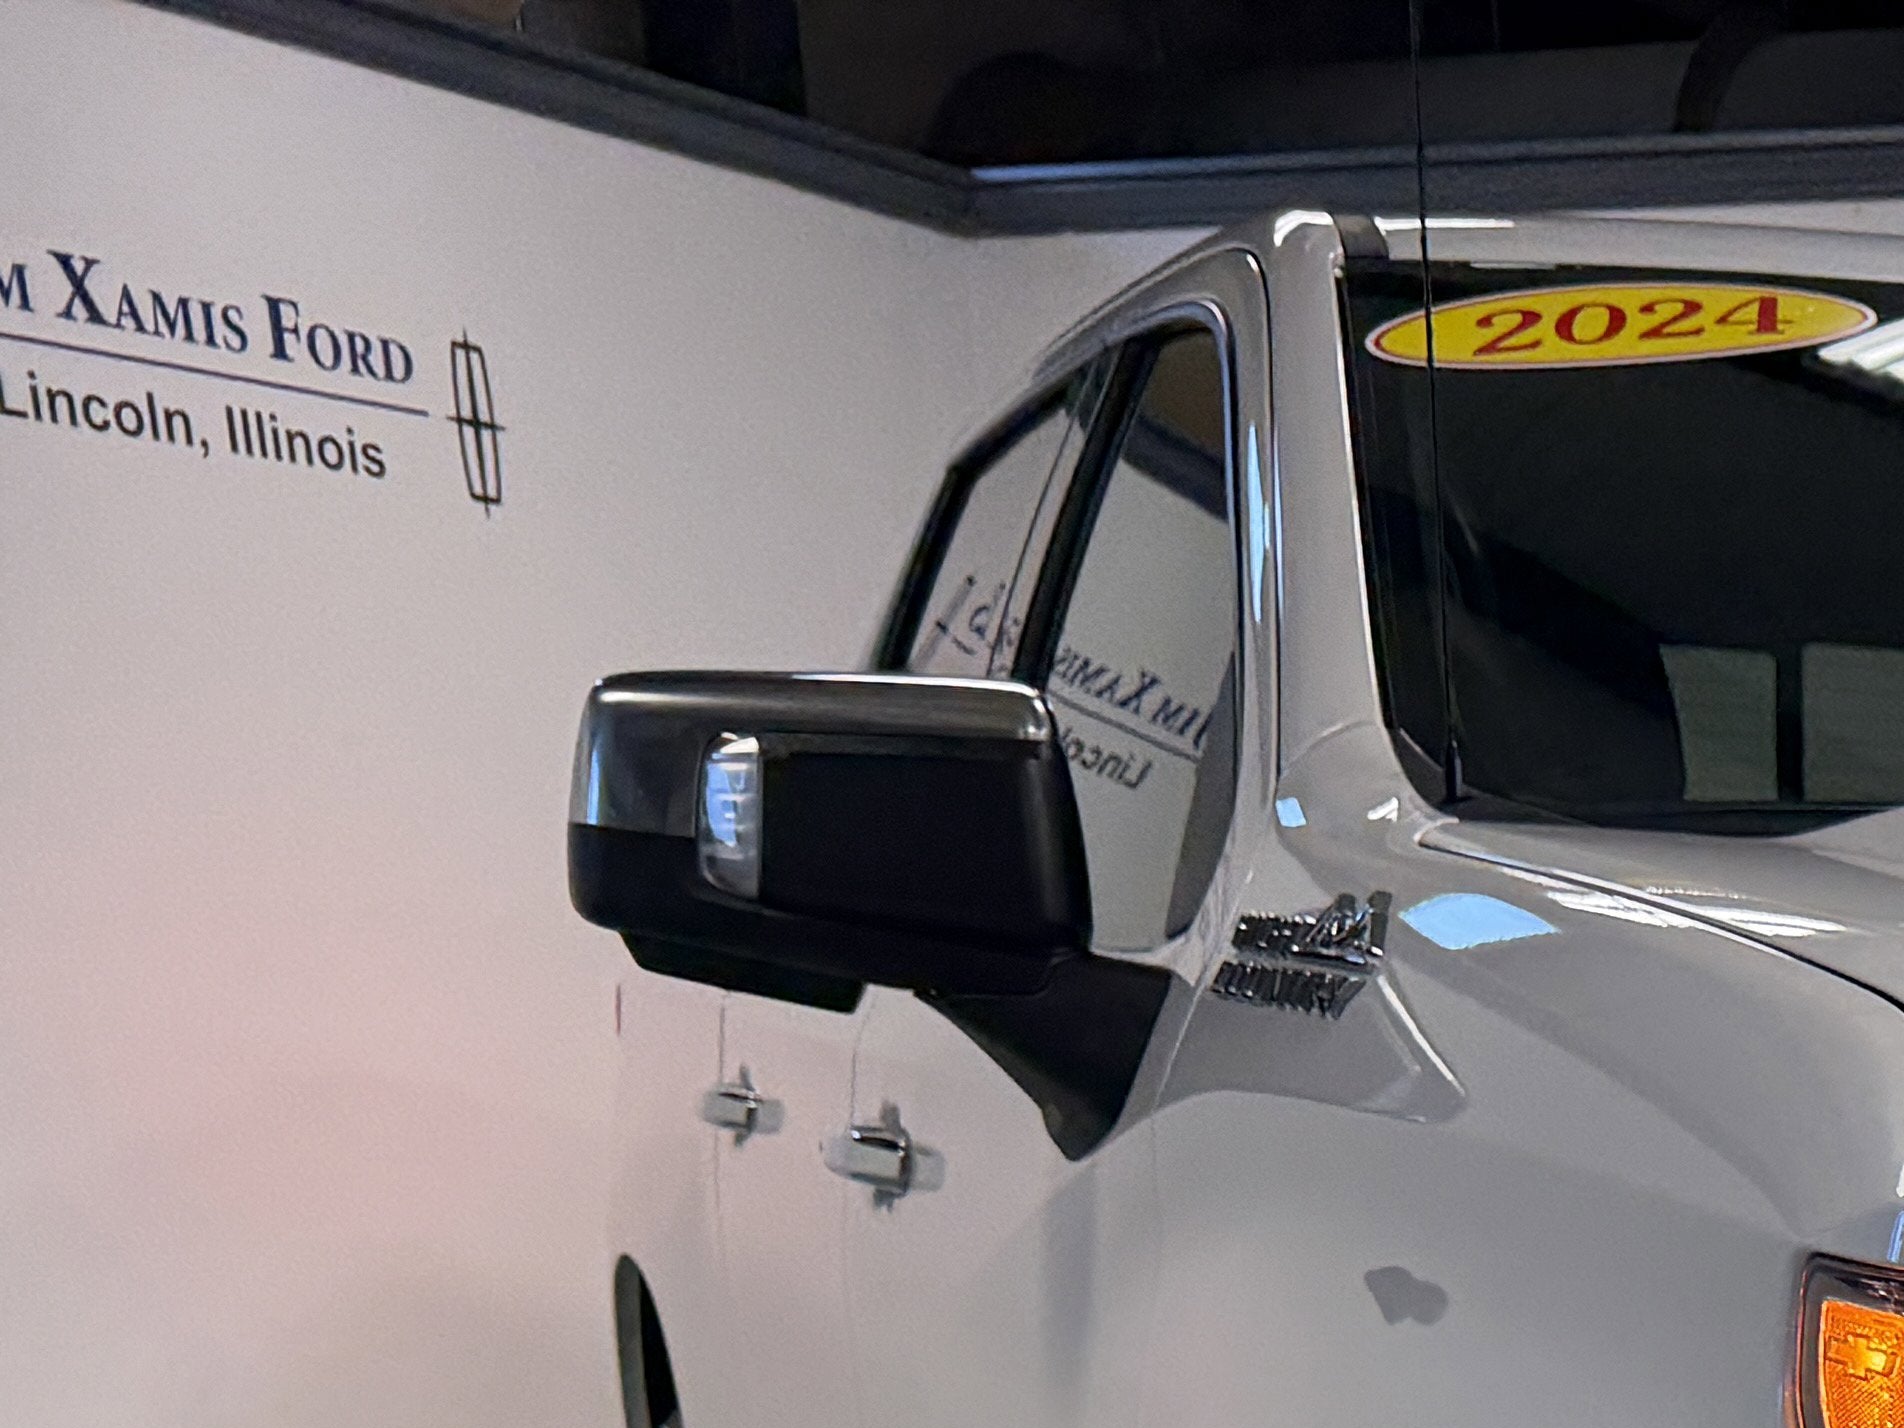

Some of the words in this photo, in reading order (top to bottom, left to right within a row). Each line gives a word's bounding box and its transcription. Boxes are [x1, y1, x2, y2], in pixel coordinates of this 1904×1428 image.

[46, 249, 250, 354] XAMIS
[260, 294, 414, 385] FORD
[1471, 295, 1796, 358] 2024
[0, 369, 210, 458] Lincoln,
[226, 404, 388, 480] Illinois
